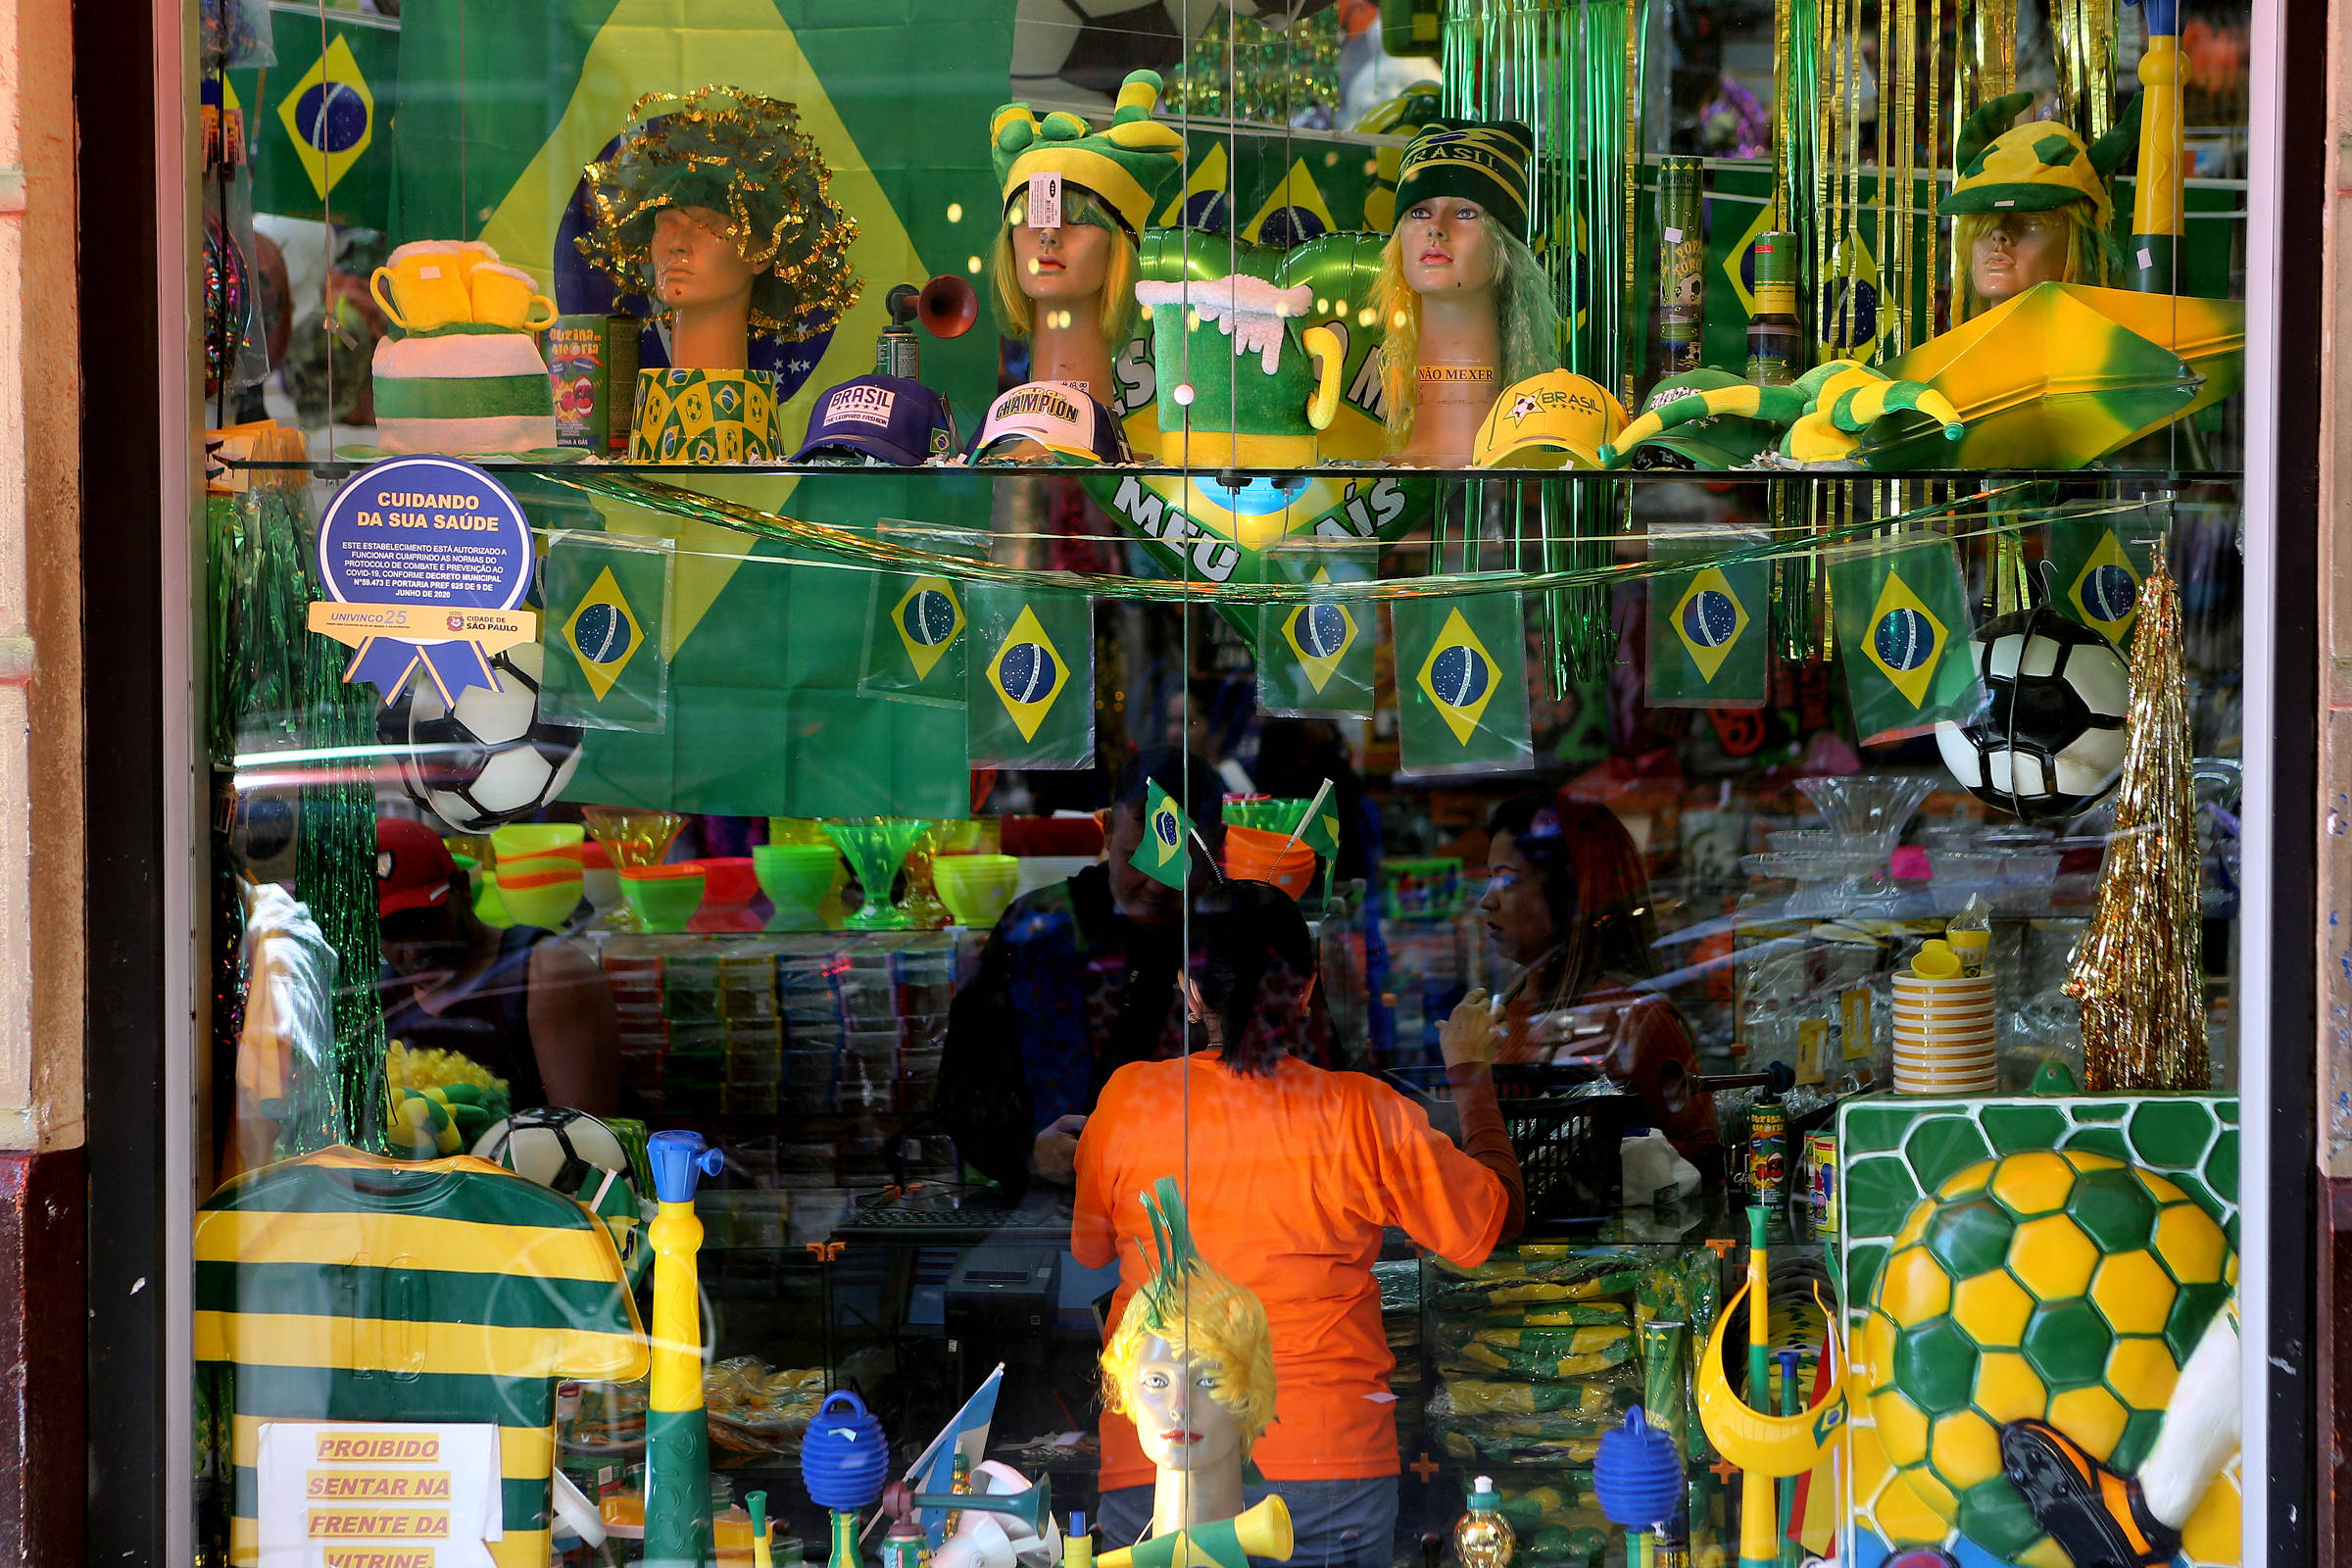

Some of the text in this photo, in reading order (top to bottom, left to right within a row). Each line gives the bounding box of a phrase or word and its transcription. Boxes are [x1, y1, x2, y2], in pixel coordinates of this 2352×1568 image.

[1446, 368, 1494, 380] MEXER
[831, 387, 890, 408] BRASIL
[1542, 391, 1602, 413] BRASIL
[995, 393, 1079, 424] CHAMPION
[377, 492, 480, 511] CUIDANDO
[357, 512, 500, 532] DA SUA SAÚDE
[1112, 475, 1242, 583] MEU
[351, 551, 394, 560] FUNCIONAR
[395, 553, 440, 562] CUMPRINDO
[452, 555, 484, 564] NORMAS
[363, 543, 432, 552] ESTABELECIMENTO
[454, 547, 501, 556] AUTORIZADO
[344, 560, 390, 568] PROTOCOLO
[446, 564, 492, 573] PREVENÇÃO
[382, 570, 424, 579] CONFORME
[425, 571, 462, 580] DECRETO
[462, 573, 502, 583] MUNICIPAL
[392, 579, 429, 589] PORTARIA
[465, 582, 475, 591] DE
[466, 621, 518, 632] SÃO PAULO
[318, 1440, 440, 1458] PROIBIDO
[307, 1477, 449, 1496] SENTAR NA
[310, 1516, 448, 1534] FRENTE DA
